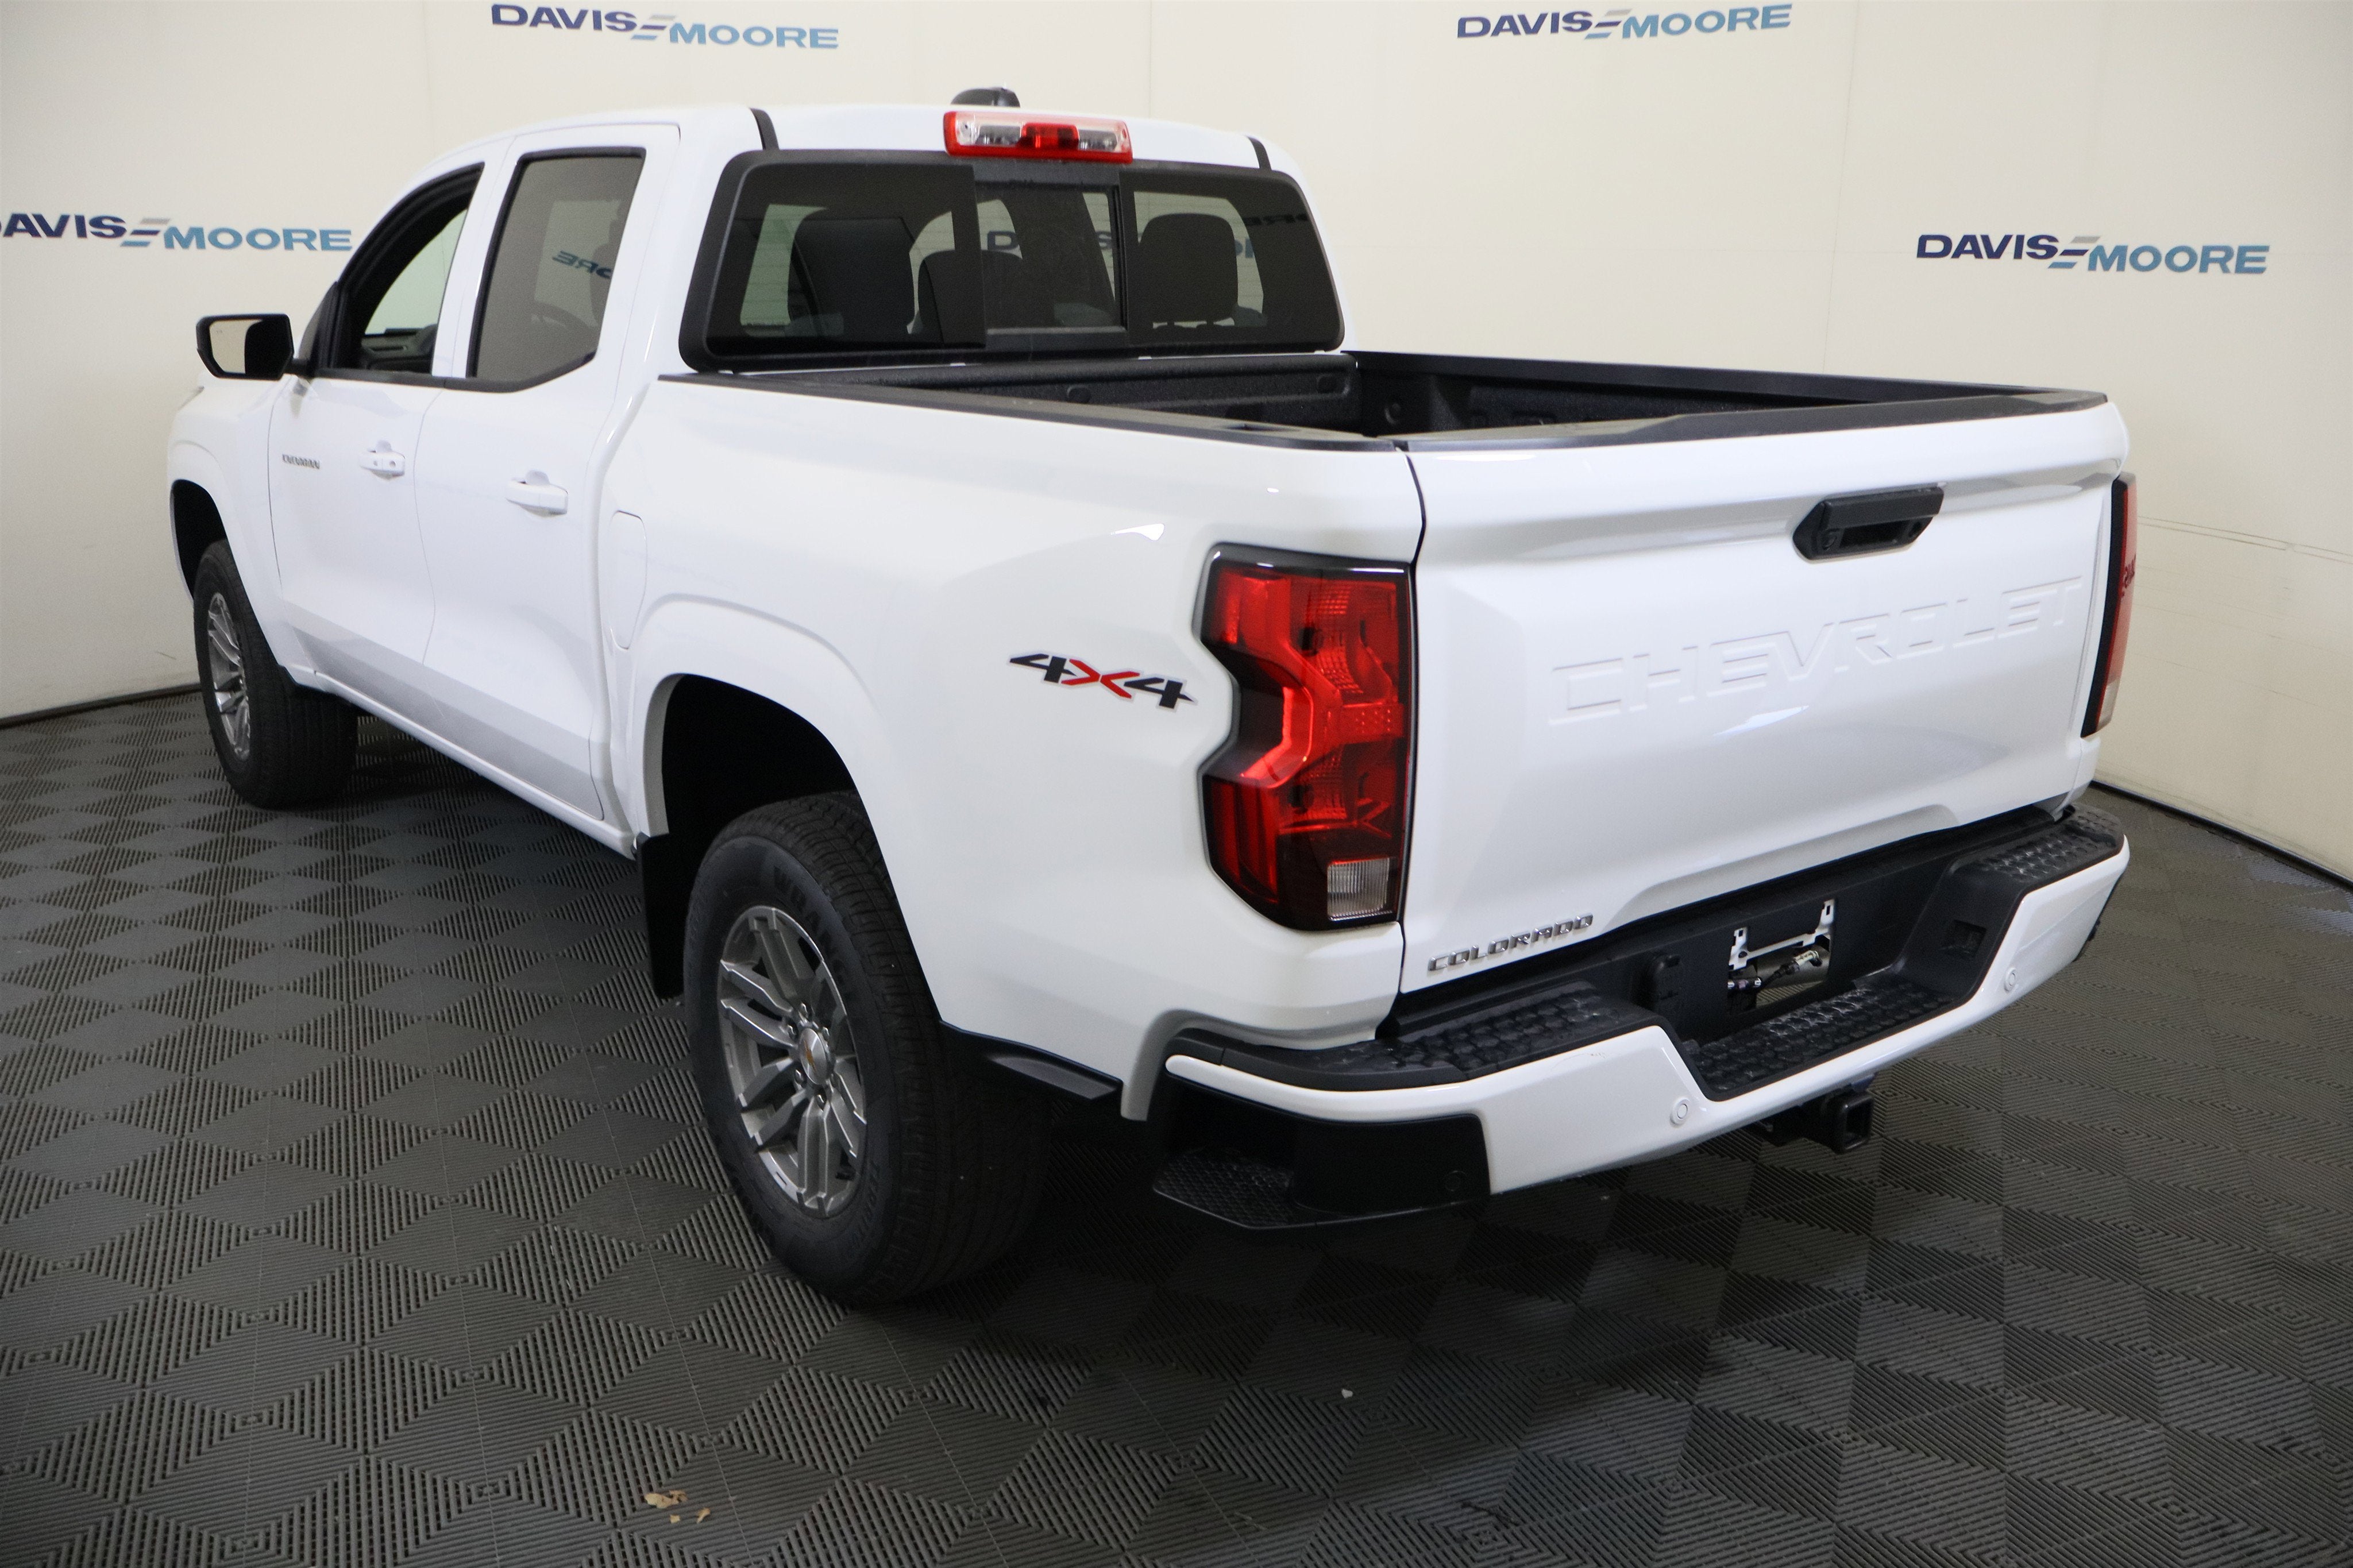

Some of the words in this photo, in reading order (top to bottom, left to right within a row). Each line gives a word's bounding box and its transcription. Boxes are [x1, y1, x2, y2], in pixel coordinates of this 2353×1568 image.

[491, 3, 638, 32] DAVIS
[669, 23, 839, 48] MOORE
[1457, 11, 1593, 38] DAVIS
[1622, 4, 1792, 39] MOORE
[0, 213, 128, 240] AVIS
[163, 227, 353, 251] MOORE
[1916, 234, 2059, 260] DAVIS
[2088, 245, 2270, 275] MOORE
[1549, 575, 2082, 726] CHEVROLET
[1428, 912, 1594, 971] COLORADO
